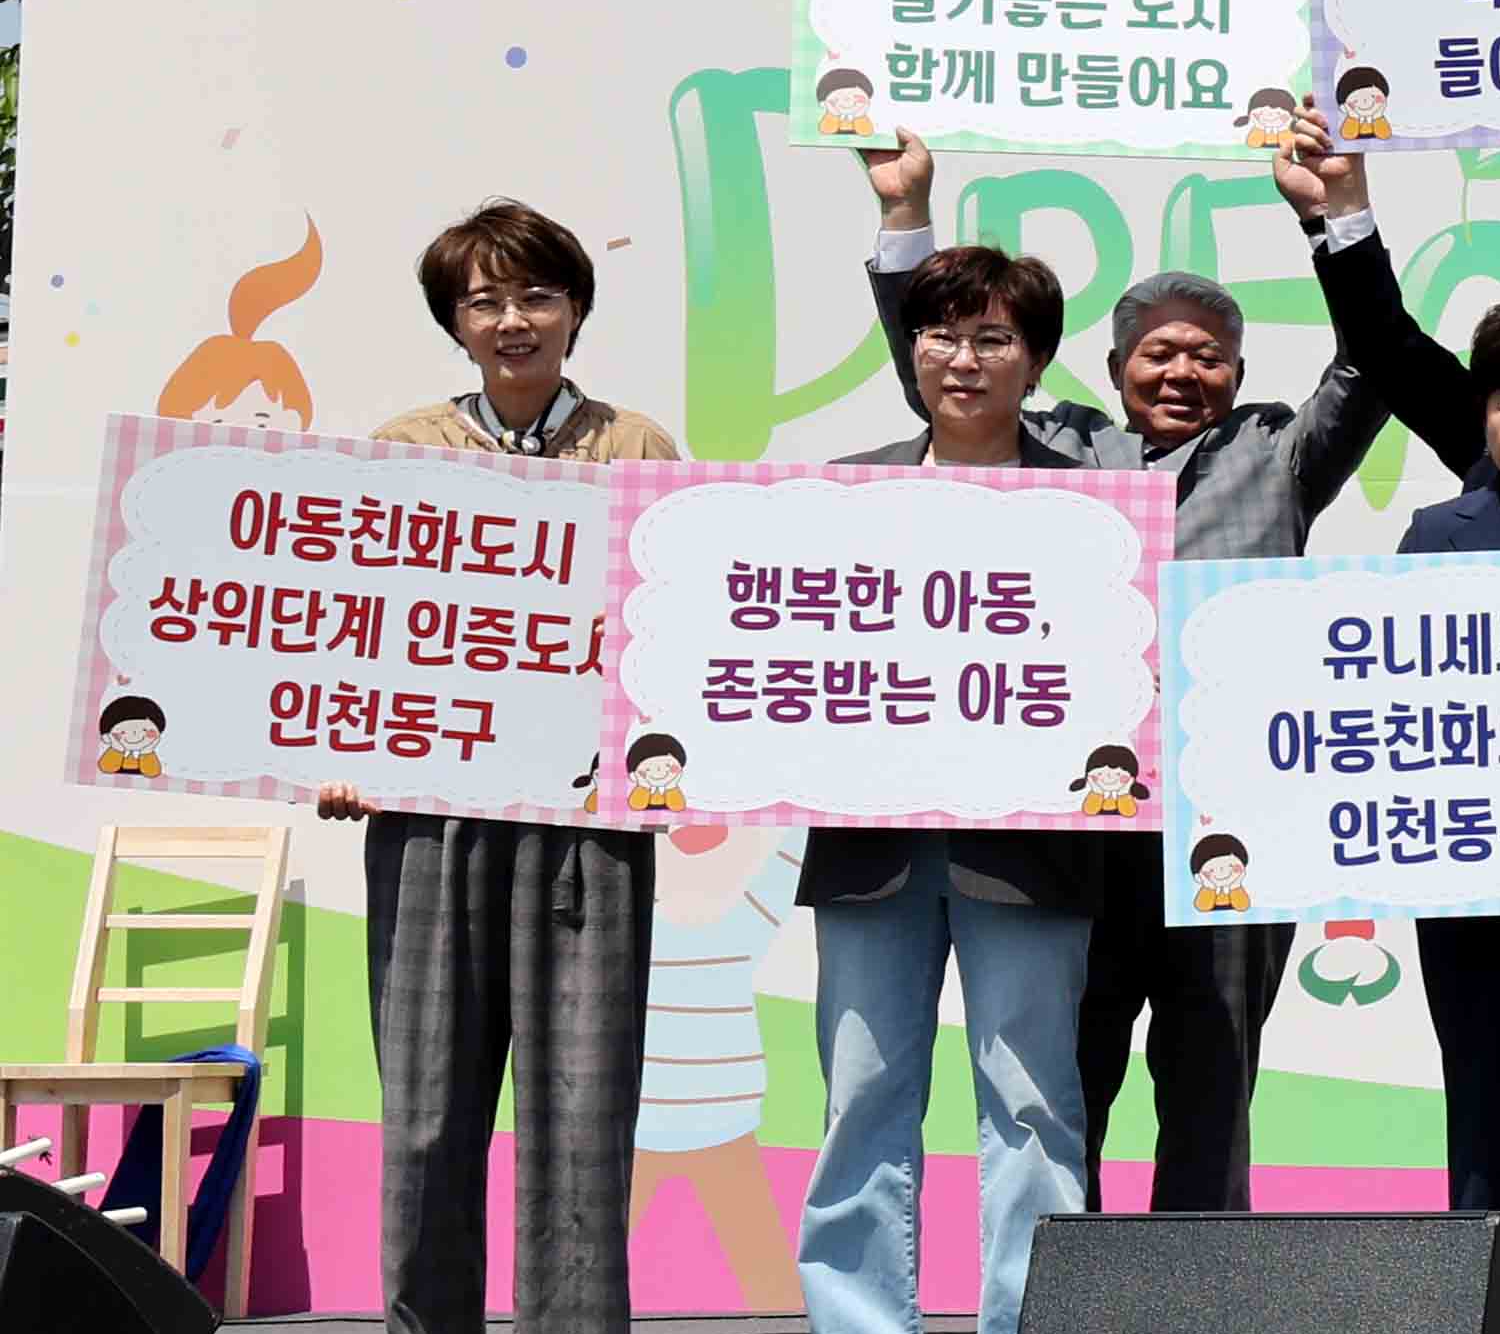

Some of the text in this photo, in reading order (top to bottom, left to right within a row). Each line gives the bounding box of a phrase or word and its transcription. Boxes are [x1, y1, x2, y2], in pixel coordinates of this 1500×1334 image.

[886, 43, 1232, 110] 함께 만들어요
[230, 490, 576, 585] 아동친화도시
[149, 577, 385, 659] 상위단계
[726, 560, 1050, 639] 행복한 아동,
[270, 681, 496, 761] 인천동구
[702, 659, 1071, 727] 존중받는 아동
